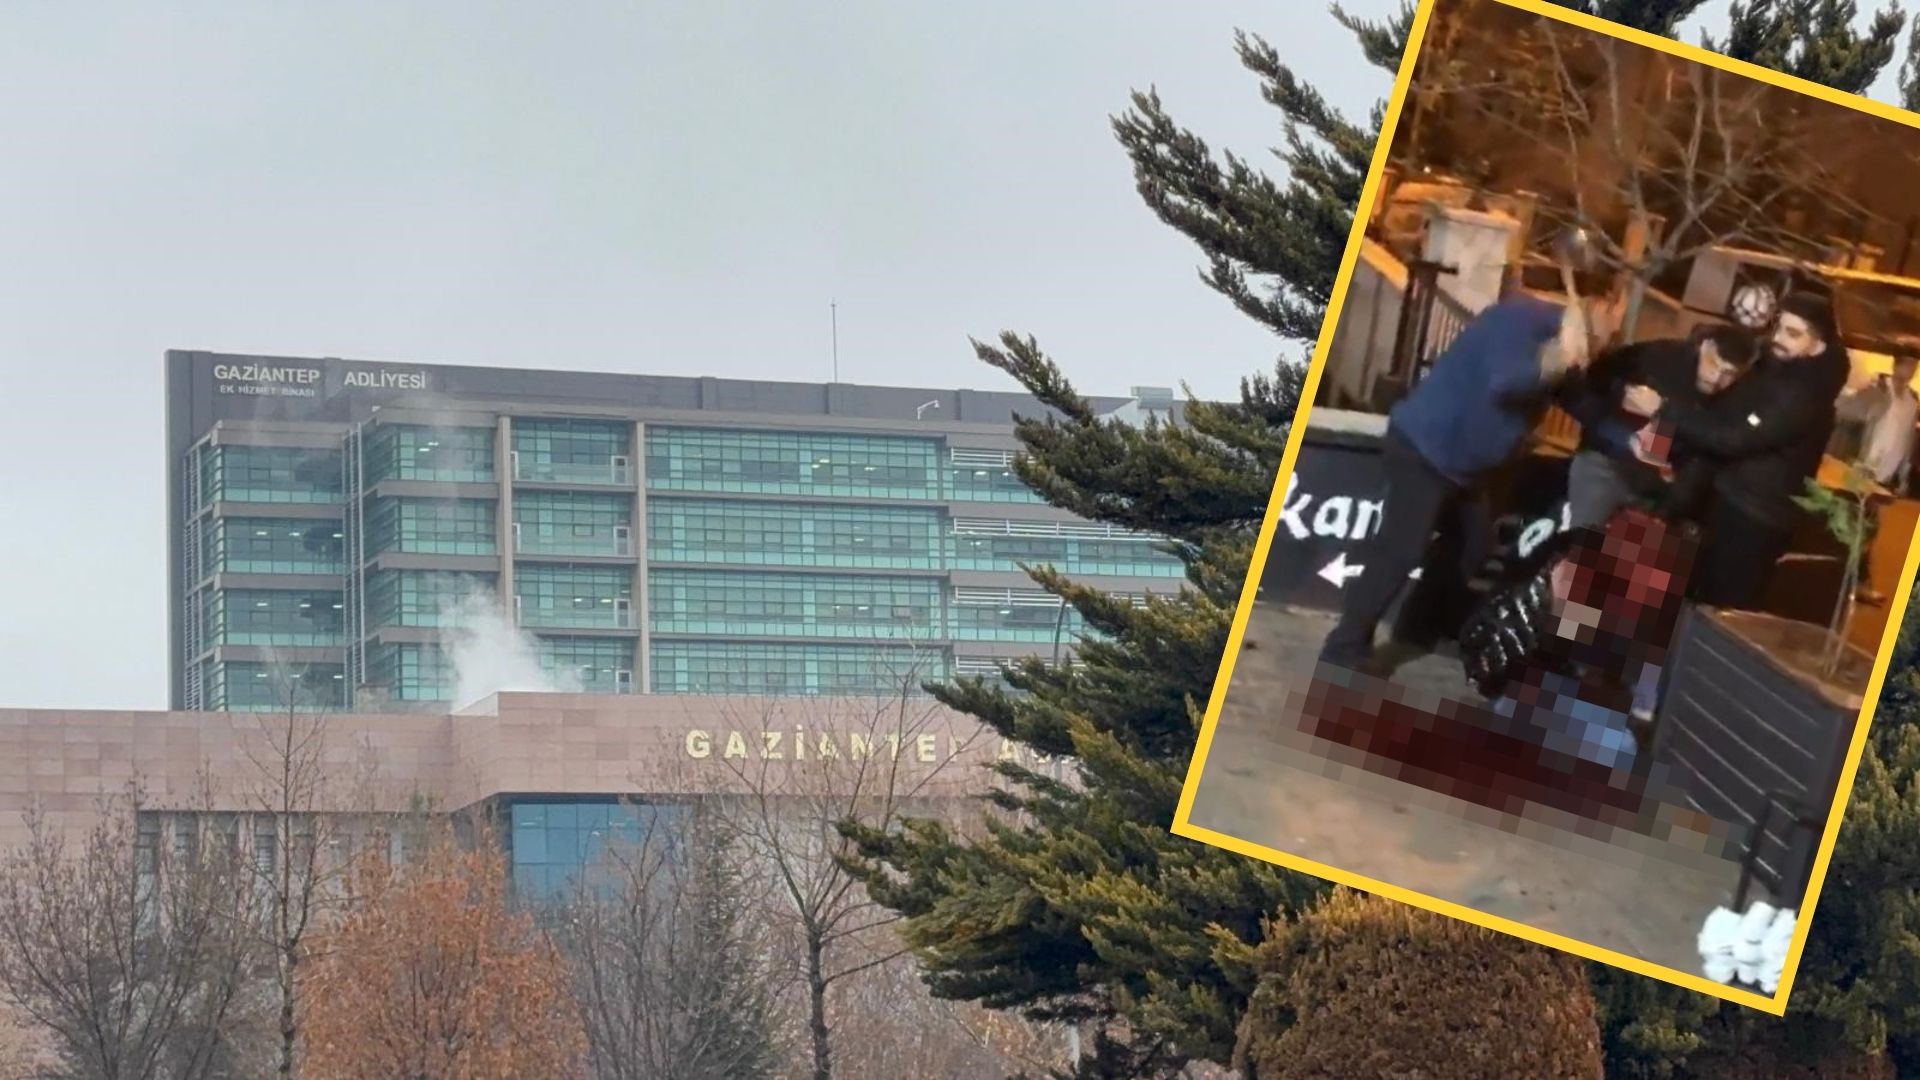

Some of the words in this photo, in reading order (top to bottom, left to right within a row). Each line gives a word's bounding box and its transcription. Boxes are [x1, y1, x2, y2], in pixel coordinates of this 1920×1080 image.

[213, 363, 320, 384] GAZİANTEP
[343, 369, 426, 389] ADLİYESİ
[220, 384, 234, 394] EK
